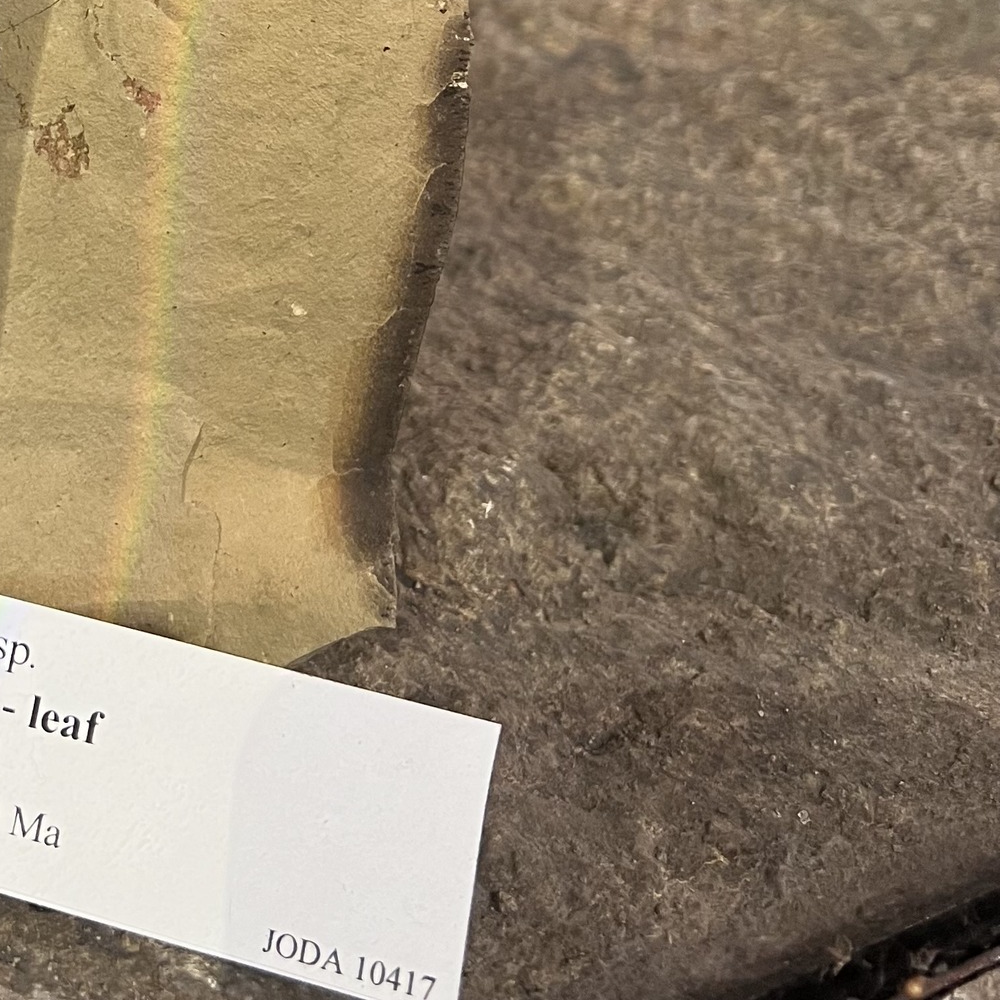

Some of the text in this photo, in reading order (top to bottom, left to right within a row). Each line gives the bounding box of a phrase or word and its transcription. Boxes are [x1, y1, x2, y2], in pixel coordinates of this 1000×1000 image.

[27, 694, 106, 745] leaf
[7, 804, 62, 850] Ma
[262, 928, 438, 1000] JODA 10417
